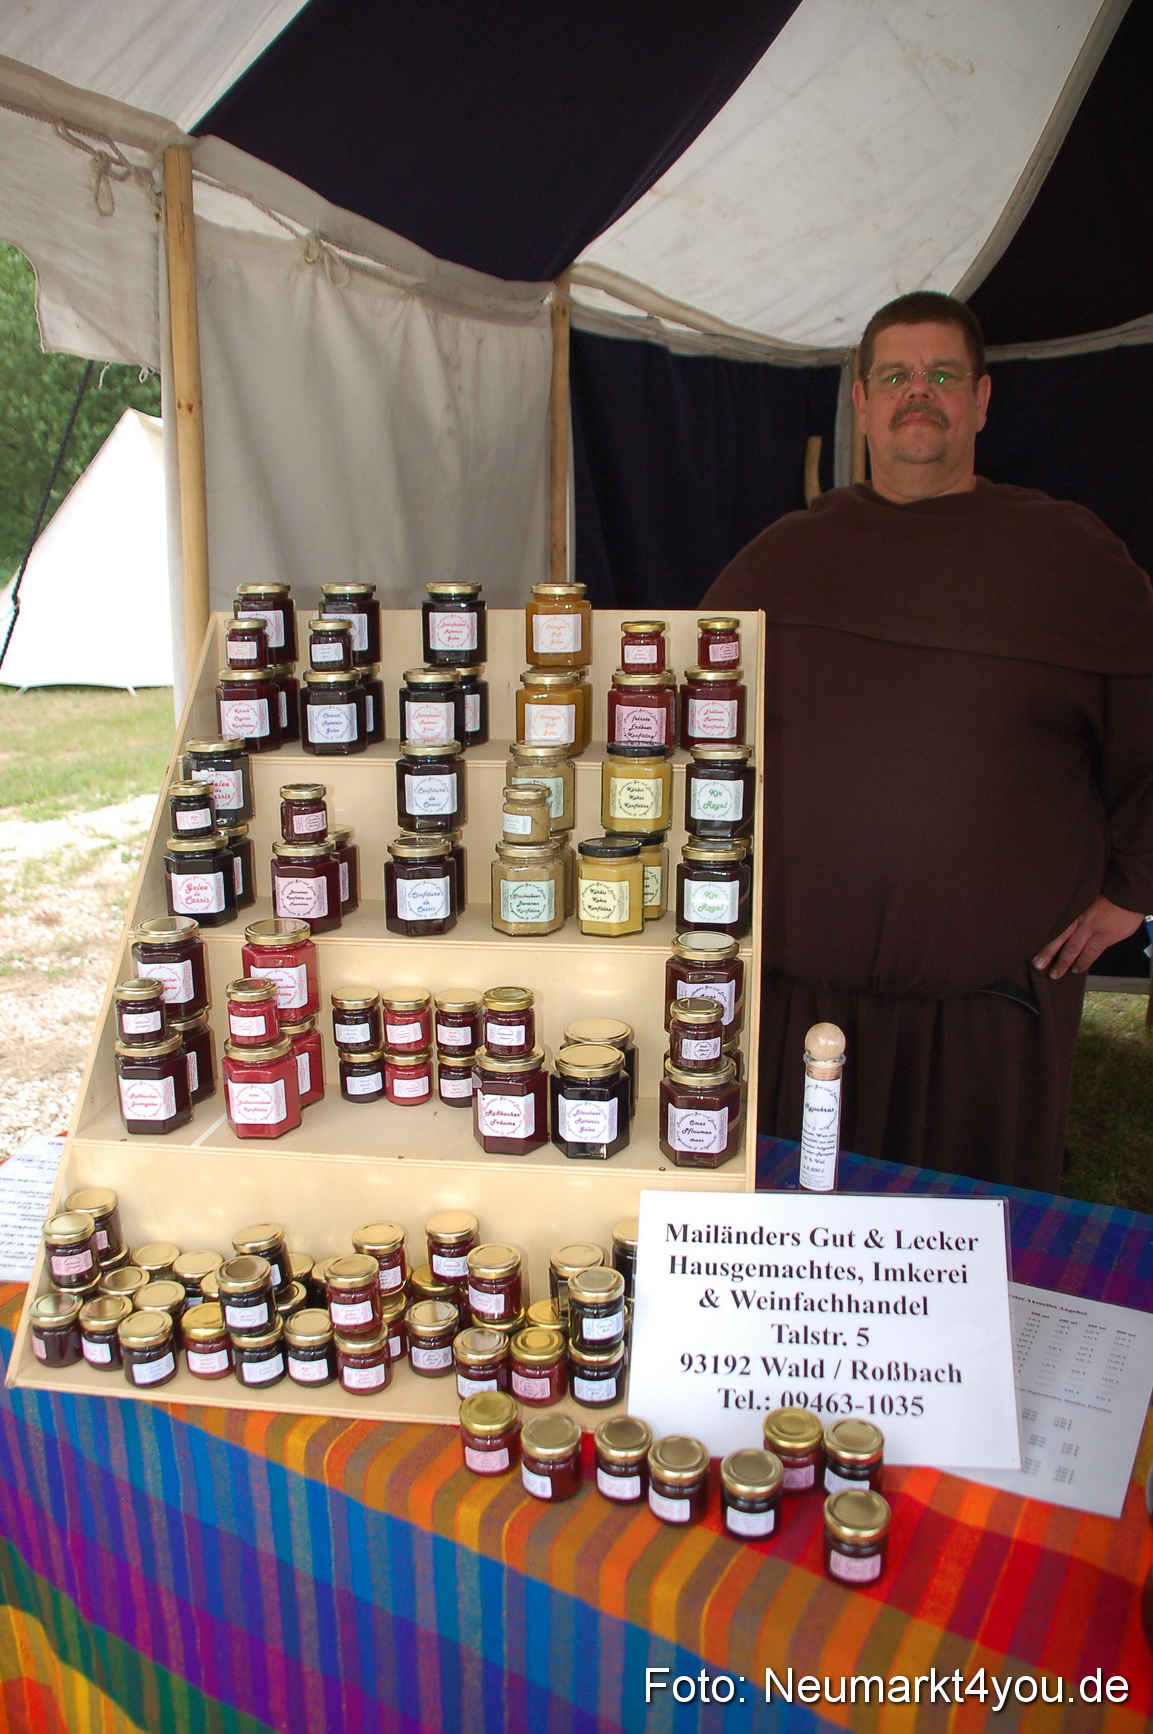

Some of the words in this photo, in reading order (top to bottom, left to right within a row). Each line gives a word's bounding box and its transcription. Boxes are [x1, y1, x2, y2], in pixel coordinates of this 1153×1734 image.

[709, 789, 723, 797] Kir
[702, 801, 728, 811] Royal
[186, 883, 208, 894] Gelee
[412, 891, 440, 899] Confiture
[704, 891, 718, 899] Kir
[697, 903, 724, 914] Royal
[805, 1102, 834, 1112] Hypokras
[667, 1224, 800, 1246] Mailänders
[810, 1228, 855, 1247] Gut
[864, 1229, 884, 1248] &
[896, 1230, 978, 1251] Lecker
[670, 1256, 863, 1283] Hausgemachtes,
[874, 1262, 967, 1283] Imkerei
[699, 1289, 718, 1308] &
[731, 1290, 928, 1315] Weinfachhandel
[1026, 1299, 1057, 1309] Aktuelles
[1059, 1306, 1088, 1315] Angebot
[772, 1324, 847, 1346] Talstr.
[857, 1328, 869, 1346] 5
[681, 1354, 750, 1375] 93192
[761, 1357, 824, 1378] Wald
[834, 1360, 841, 1379] /
[852, 1361, 961, 1383] Roßbach
[718, 1389, 770, 1410] Tel.:
[780, 1391, 924, 1417] 09463-1035
